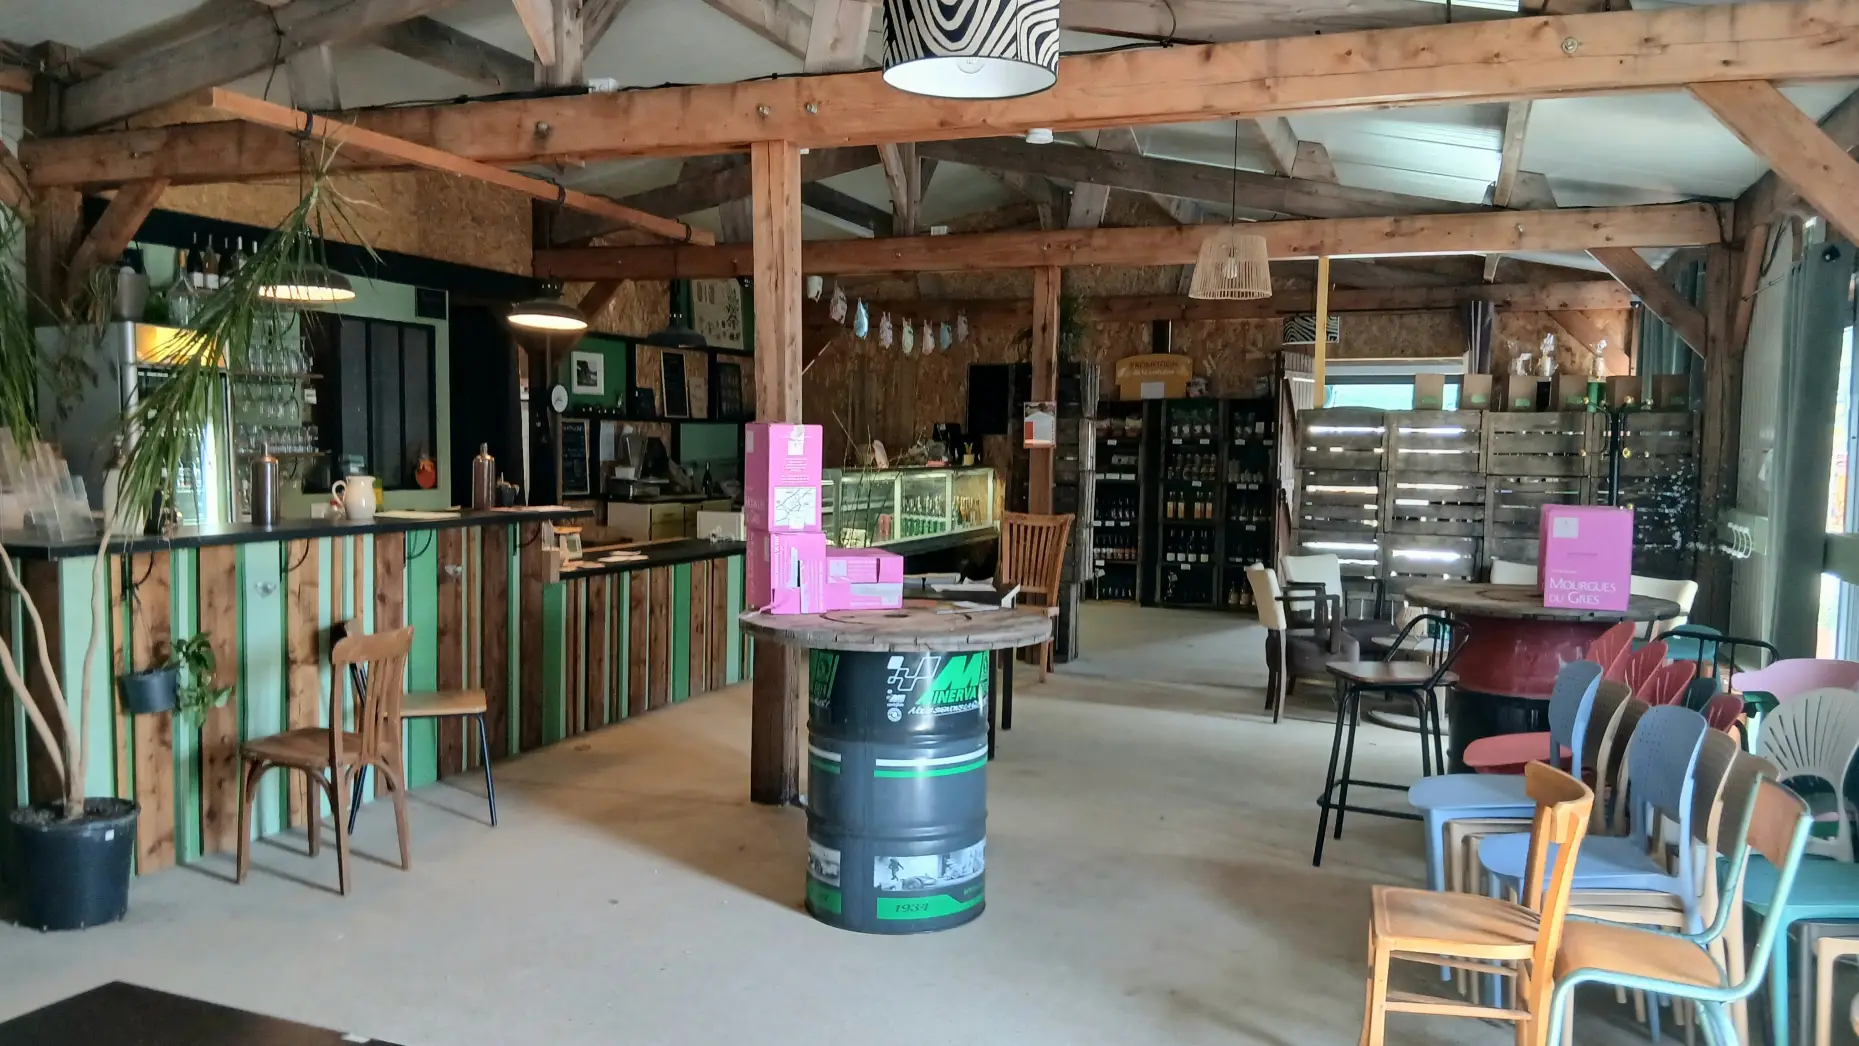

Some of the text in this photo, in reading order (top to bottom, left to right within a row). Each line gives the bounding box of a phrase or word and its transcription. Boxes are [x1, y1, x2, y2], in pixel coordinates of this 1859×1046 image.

[1549, 577, 1617, 593] MOURGUES
[914, 652, 984, 706] MINERVA
[895, 902, 930, 914] 1934
